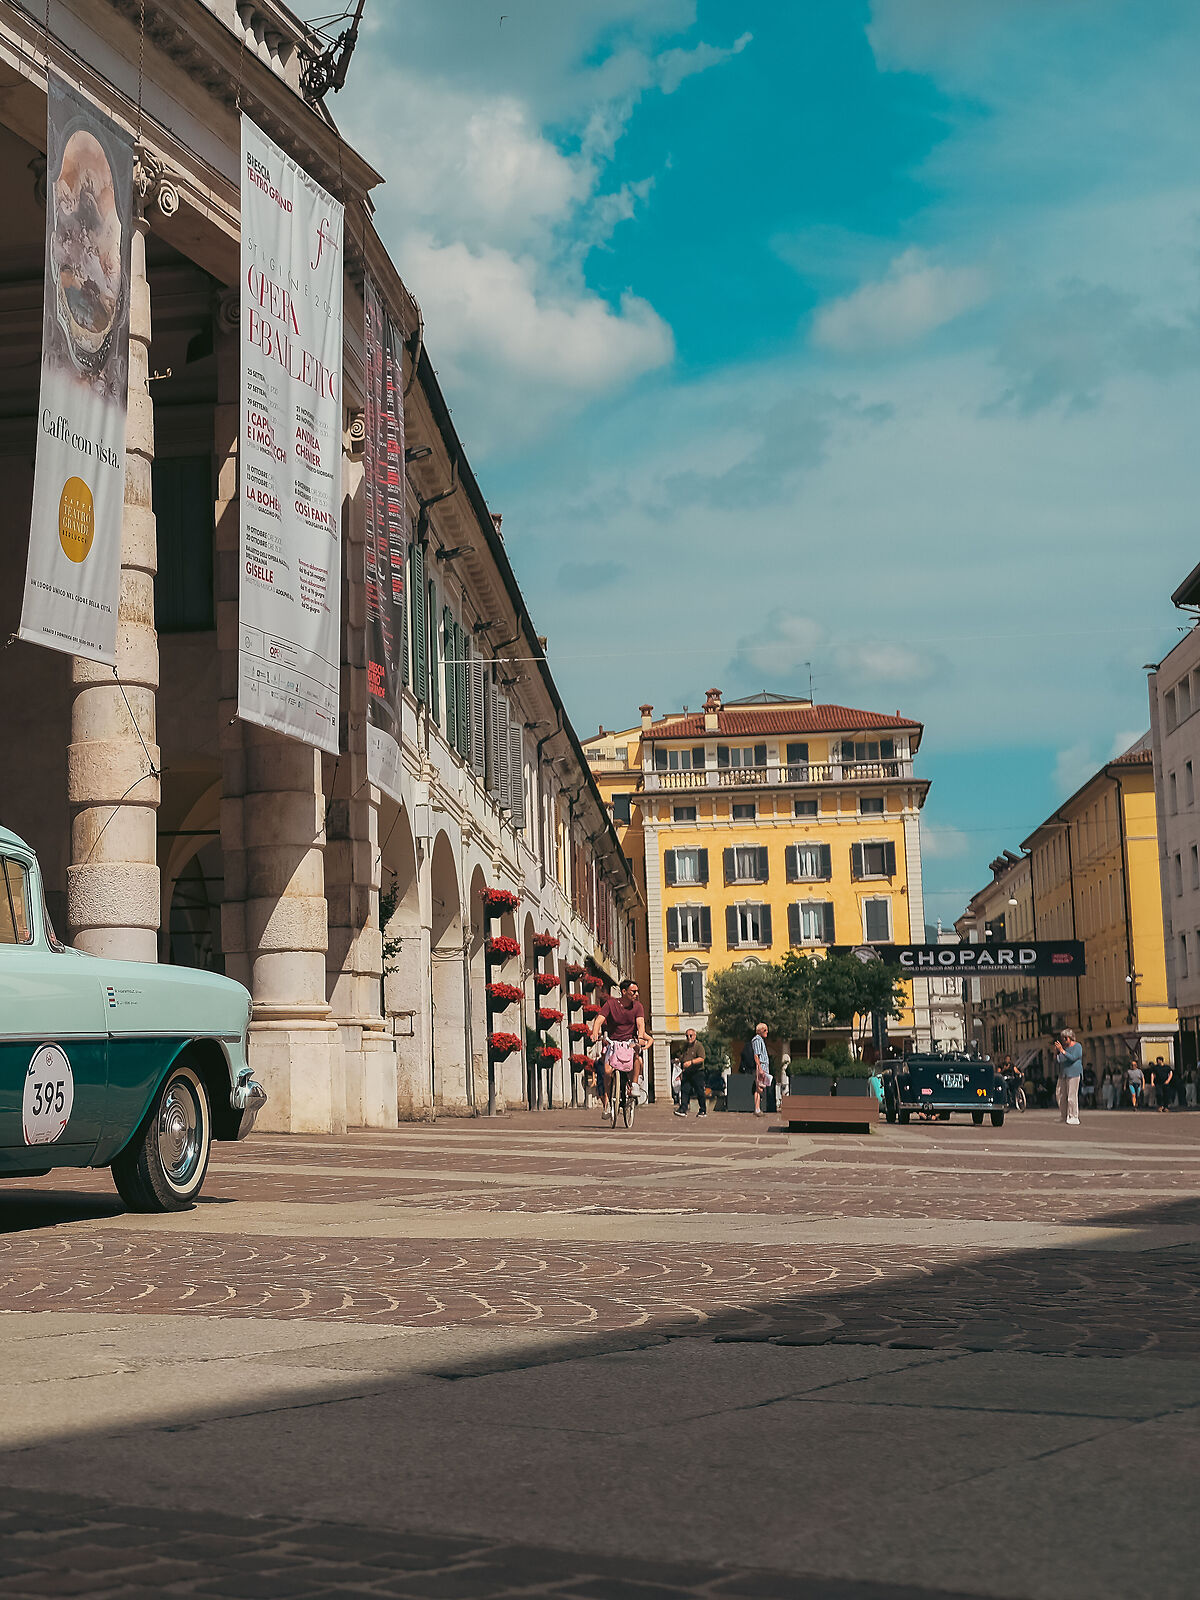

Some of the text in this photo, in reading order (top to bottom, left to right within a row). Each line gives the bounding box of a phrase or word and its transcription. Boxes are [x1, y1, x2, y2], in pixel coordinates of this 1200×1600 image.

[71, 433, 92, 456] con
[95, 438, 120, 469] vista.
[246, 485, 256, 502] LA
[64, 503, 91, 523] TEATRO
[311, 507, 327, 524] FAN
[62, 515, 89, 536] GRANDE
[246, 561, 274, 584] GISELLE
[899, 949, 1037, 966] CHOPARD
[32, 1081, 65, 1116] 395
[976, 1088, 987, 1097] 91
